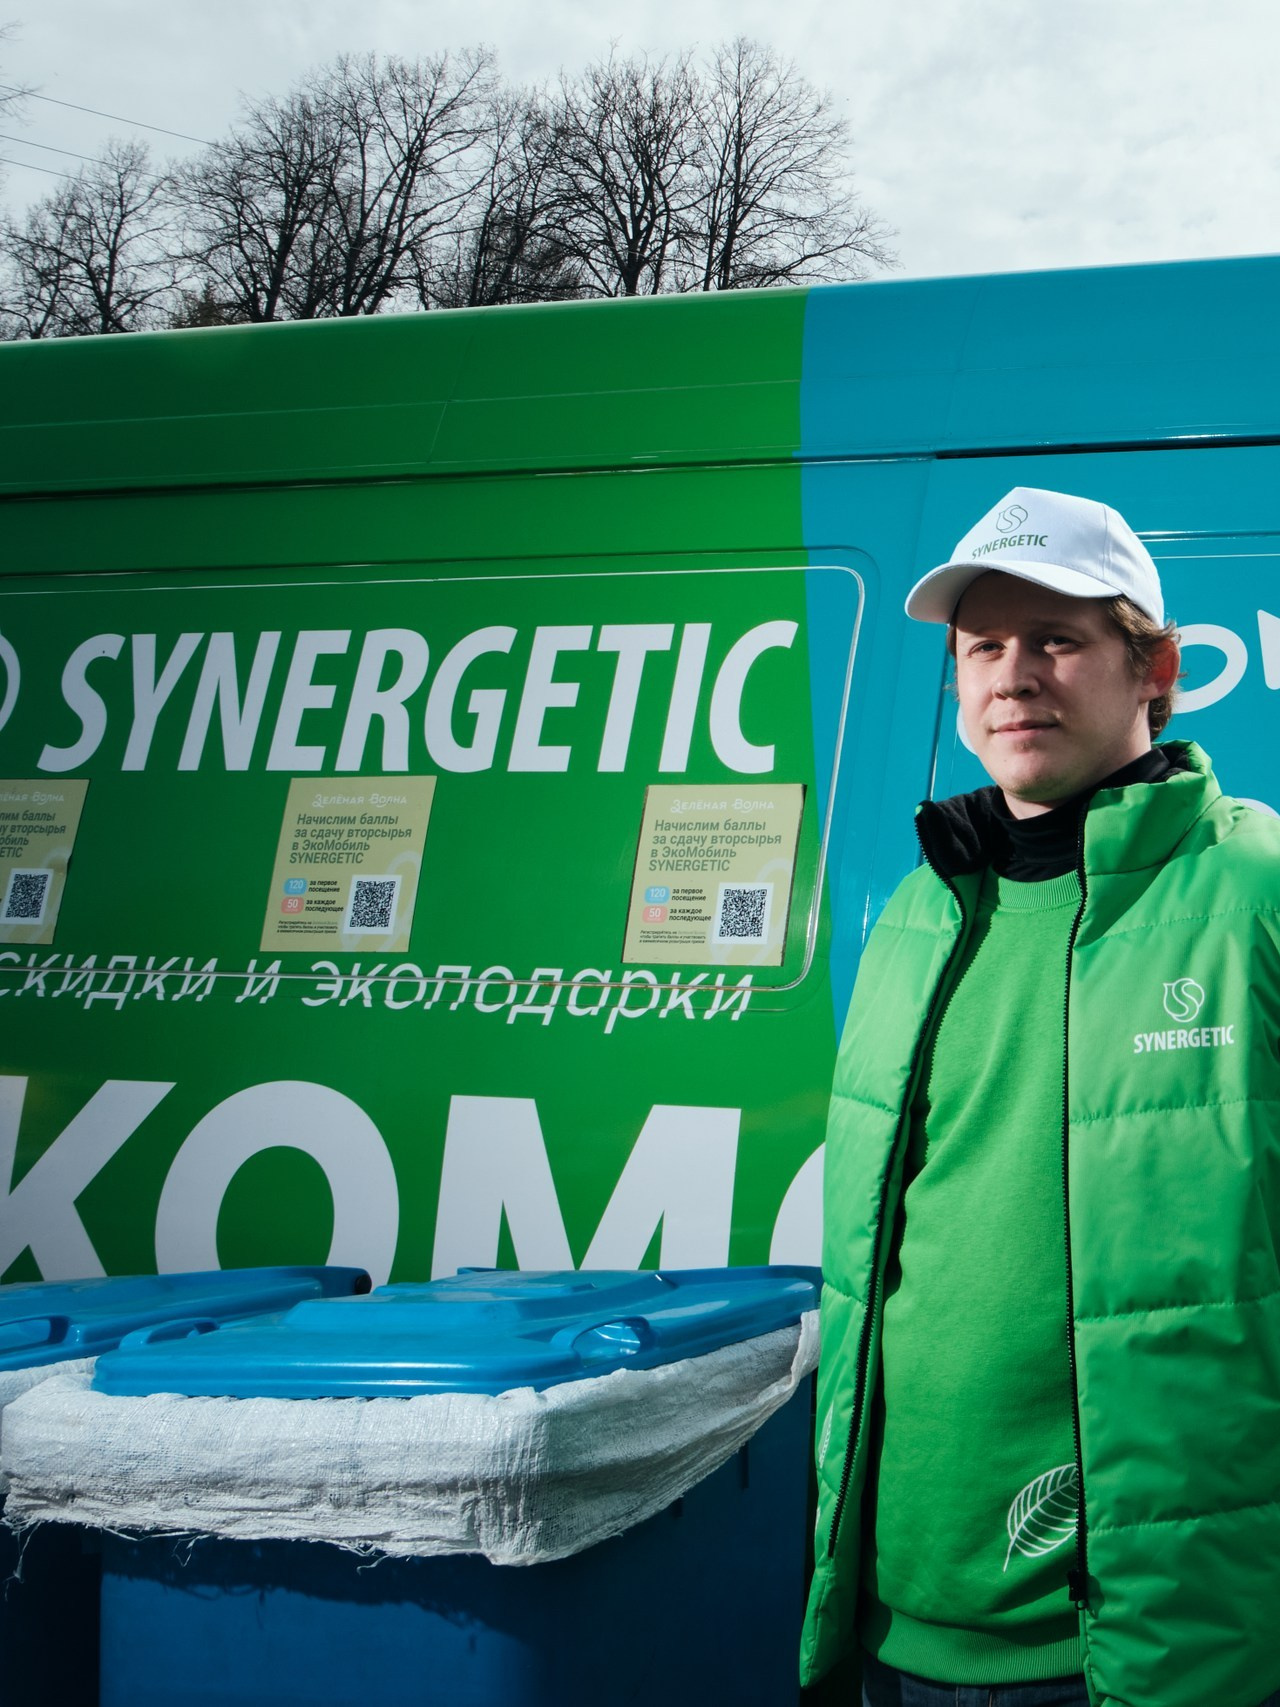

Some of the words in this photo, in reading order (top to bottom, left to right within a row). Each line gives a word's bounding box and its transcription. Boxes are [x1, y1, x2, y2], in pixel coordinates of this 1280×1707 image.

[971, 534, 1049, 560] SYNERGETIC
[37, 620, 799, 774] SYNERGETIC
[22, 810, 56, 821] баллы
[296, 813, 356, 825] Начислим
[359, 812, 398, 825] баллы
[10, 824, 67, 836] вторсырья
[654, 820, 720, 831] Начислим
[723, 819, 766, 831] баллы
[294, 829, 308, 838] за
[310, 829, 345, 840] сдачу
[348, 828, 412, 840] вторсырья
[292, 842, 298, 850] в
[302, 839, 370, 851] ЭкоМобиль
[652, 835, 668, 844] за
[670, 835, 707, 846] сдачу
[710, 834, 782, 847] вторсырья
[289, 852, 364, 864] SYNERGETIC
[650, 849, 658, 857] в
[661, 846, 737, 858] ЭкоМобиль
[648, 859, 730, 872] SYNERGETIC
[650, 888, 666, 898] 120
[287, 899, 298, 908] 50
[649, 908, 661, 917] 50
[235, 959, 282, 1004] и
[301, 960, 754, 1034] экоподарки
[1133, 1024, 1235, 1054] SYNERGETIC
